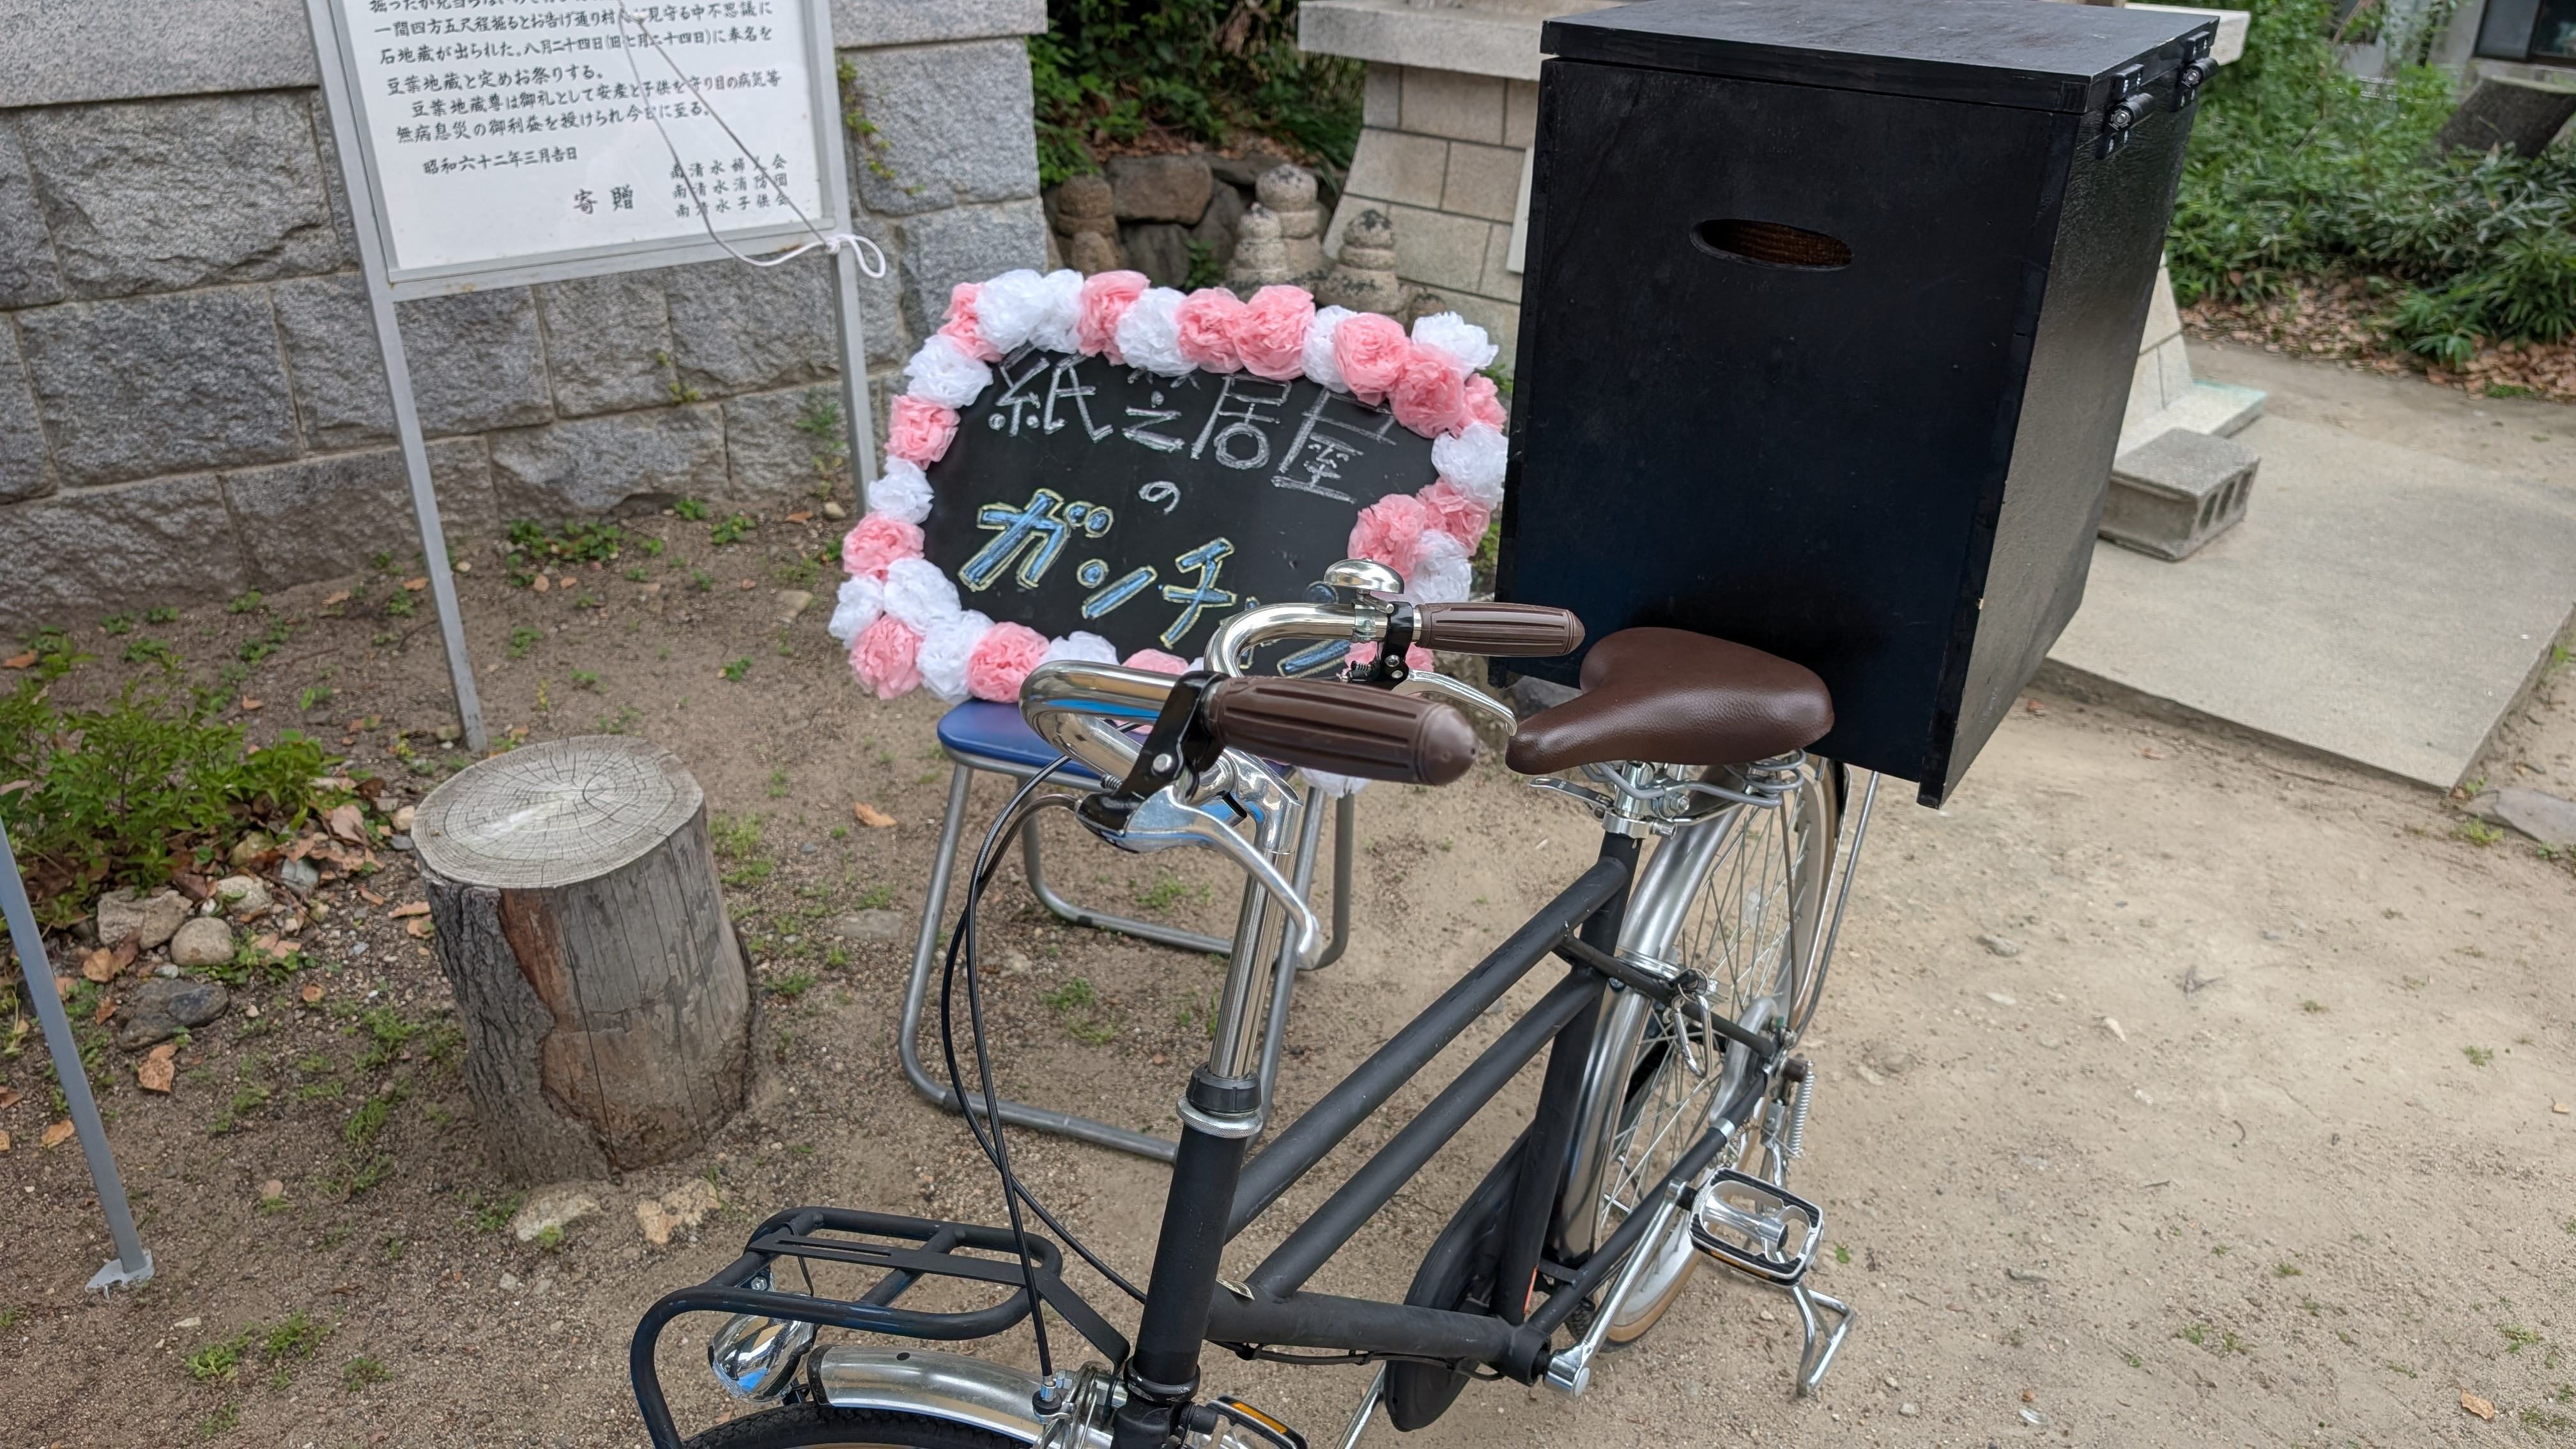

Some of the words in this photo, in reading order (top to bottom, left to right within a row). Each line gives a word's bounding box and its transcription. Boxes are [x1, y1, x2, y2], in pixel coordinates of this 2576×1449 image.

[423, 146, 578, 174] 昭和六十二年三月吉日
[573, 183, 634, 215] 寄贈
[1138, 480, 1181, 515] の
[958, 488, 1352, 678] ガンチン
